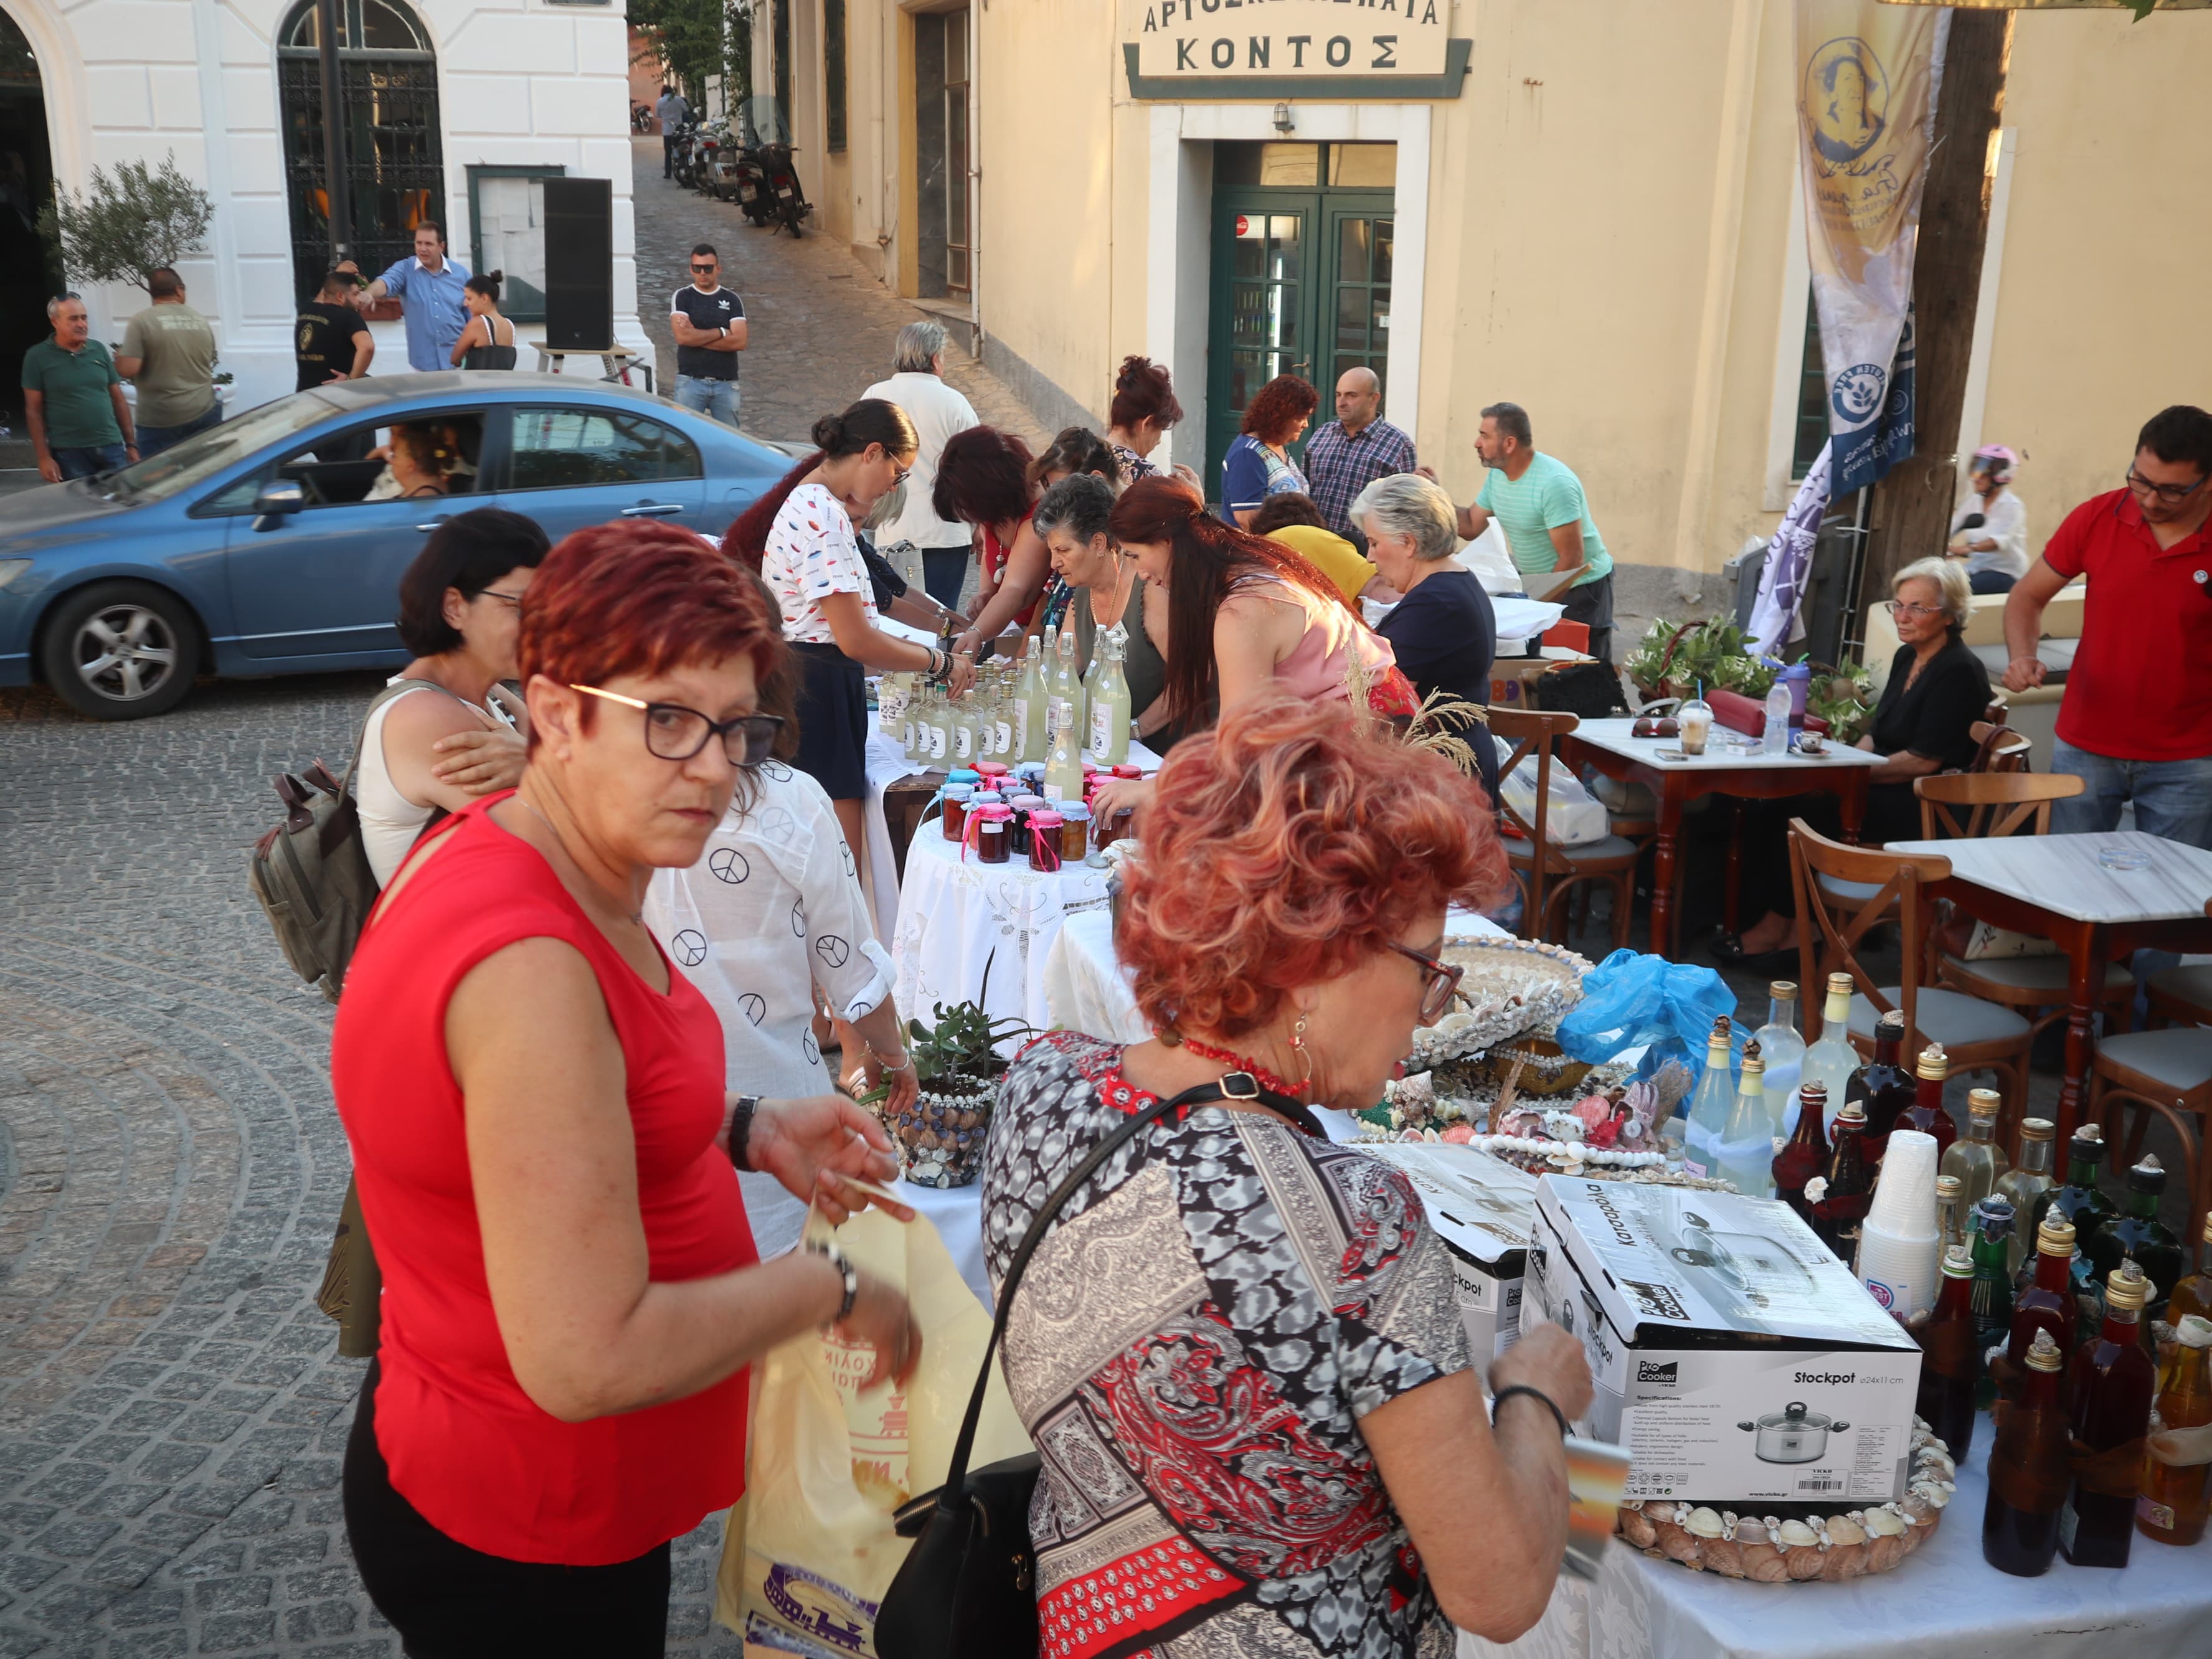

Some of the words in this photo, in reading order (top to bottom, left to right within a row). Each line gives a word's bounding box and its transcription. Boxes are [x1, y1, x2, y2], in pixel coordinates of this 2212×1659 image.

[1176, 35, 1398, 70] ΚΟΝΤΟΣ
[1649, 1285, 1685, 1318] Cooker
[1640, 1361, 1660, 1371] Pro
[1639, 1372, 1676, 1381] Cooker
[1794, 1372, 1856, 1386] Stockpot
